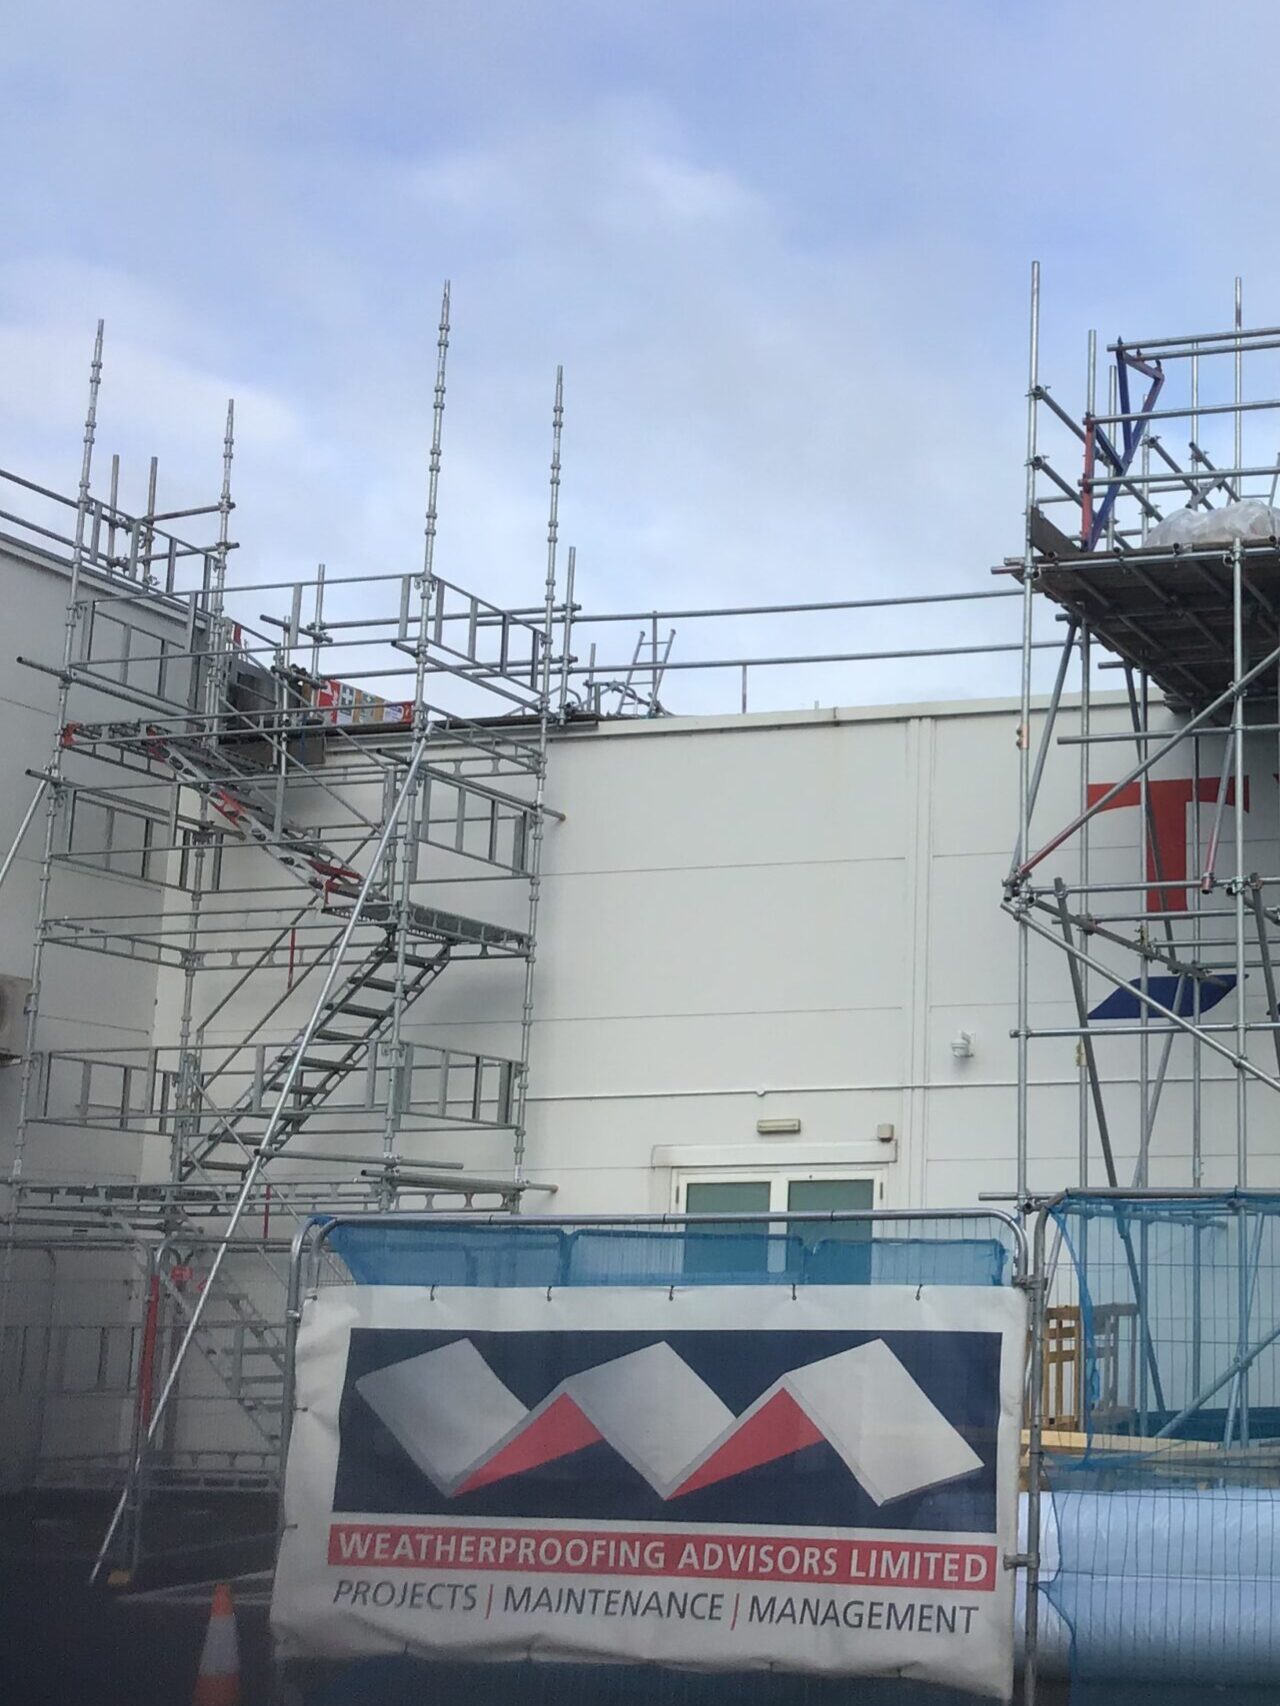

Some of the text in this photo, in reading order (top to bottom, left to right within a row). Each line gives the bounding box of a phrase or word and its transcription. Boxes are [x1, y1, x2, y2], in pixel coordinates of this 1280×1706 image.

[338, 1531, 988, 1583] WEATHERPROOFING ADVISORS LIMITED
[333, 1580, 980, 1634] PROJECTS MAINTENANCE MANAGEMENT
